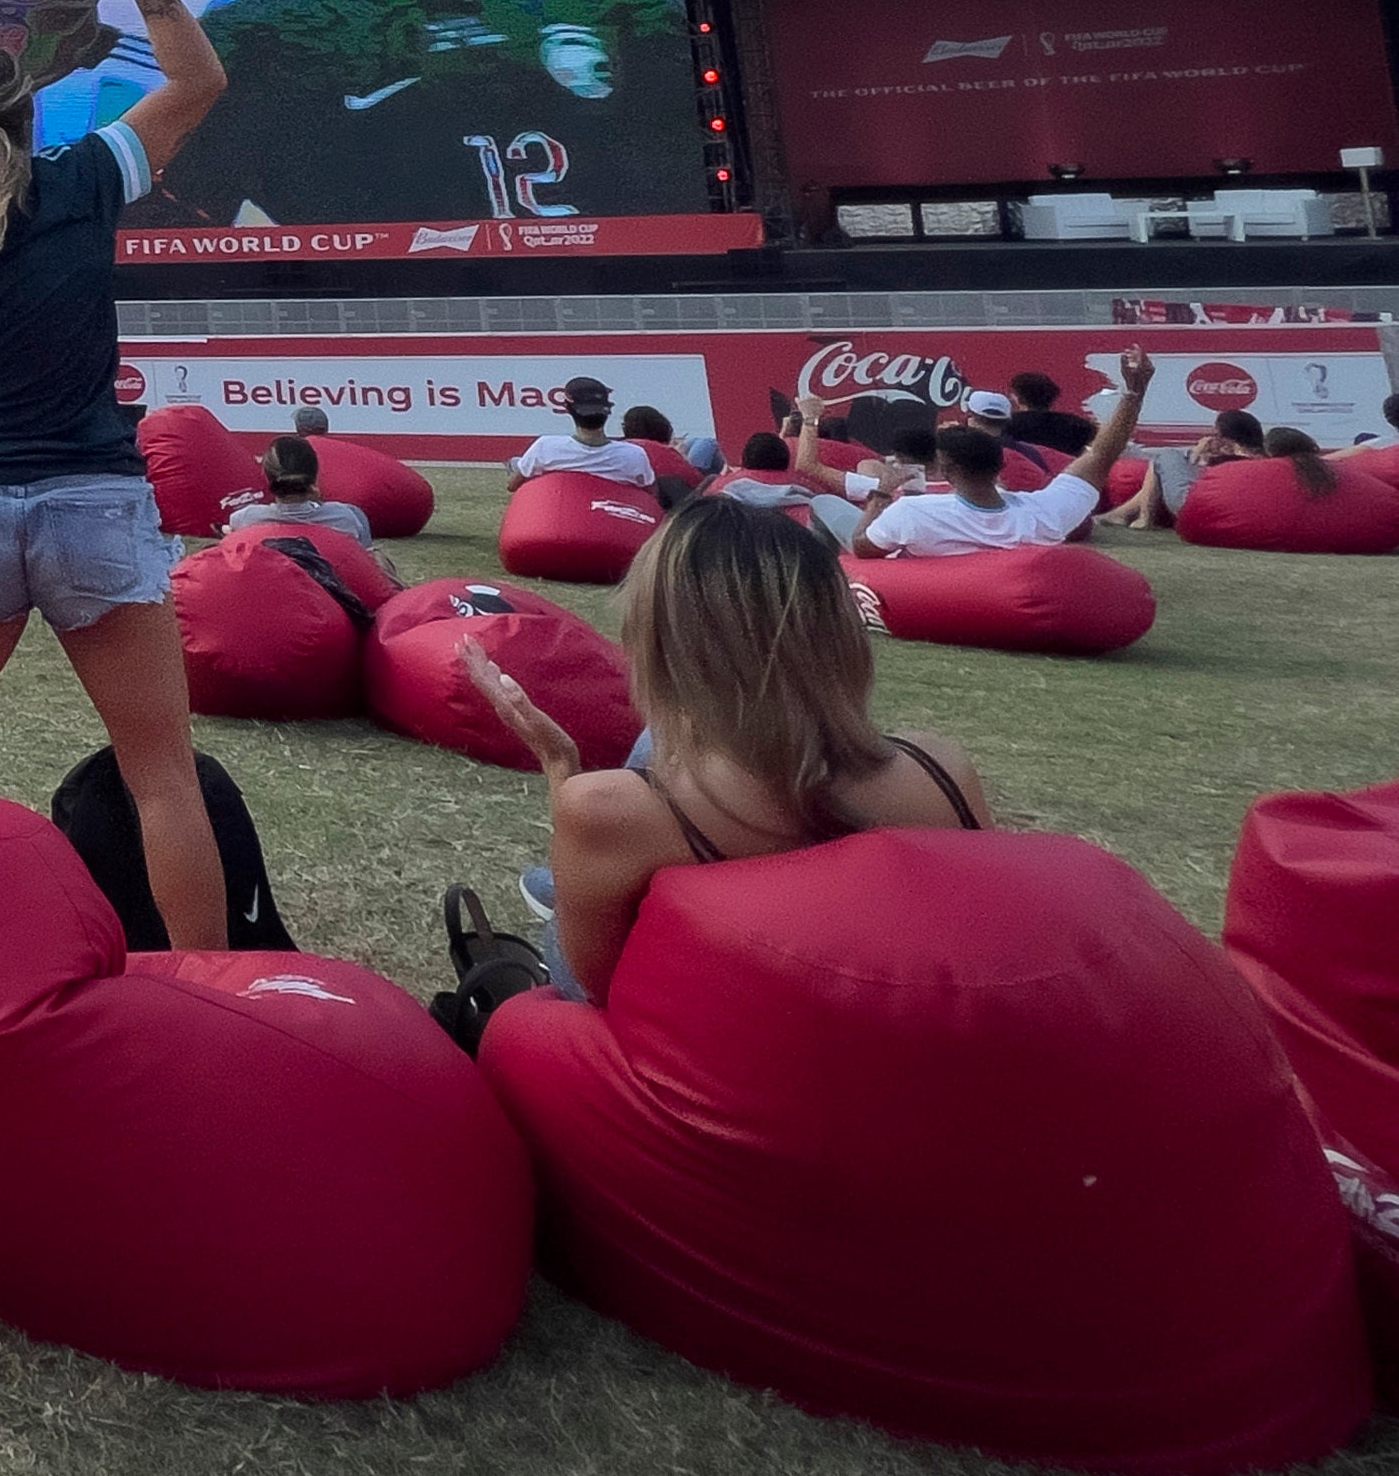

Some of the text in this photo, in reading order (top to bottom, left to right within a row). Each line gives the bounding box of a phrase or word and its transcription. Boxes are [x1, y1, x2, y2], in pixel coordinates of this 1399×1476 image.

[464, 132, 580, 218] 12
[126, 238, 185, 255] FIFA
[193, 235, 301, 254] WORLD
[223, 379, 571, 413] Believing is Mag
